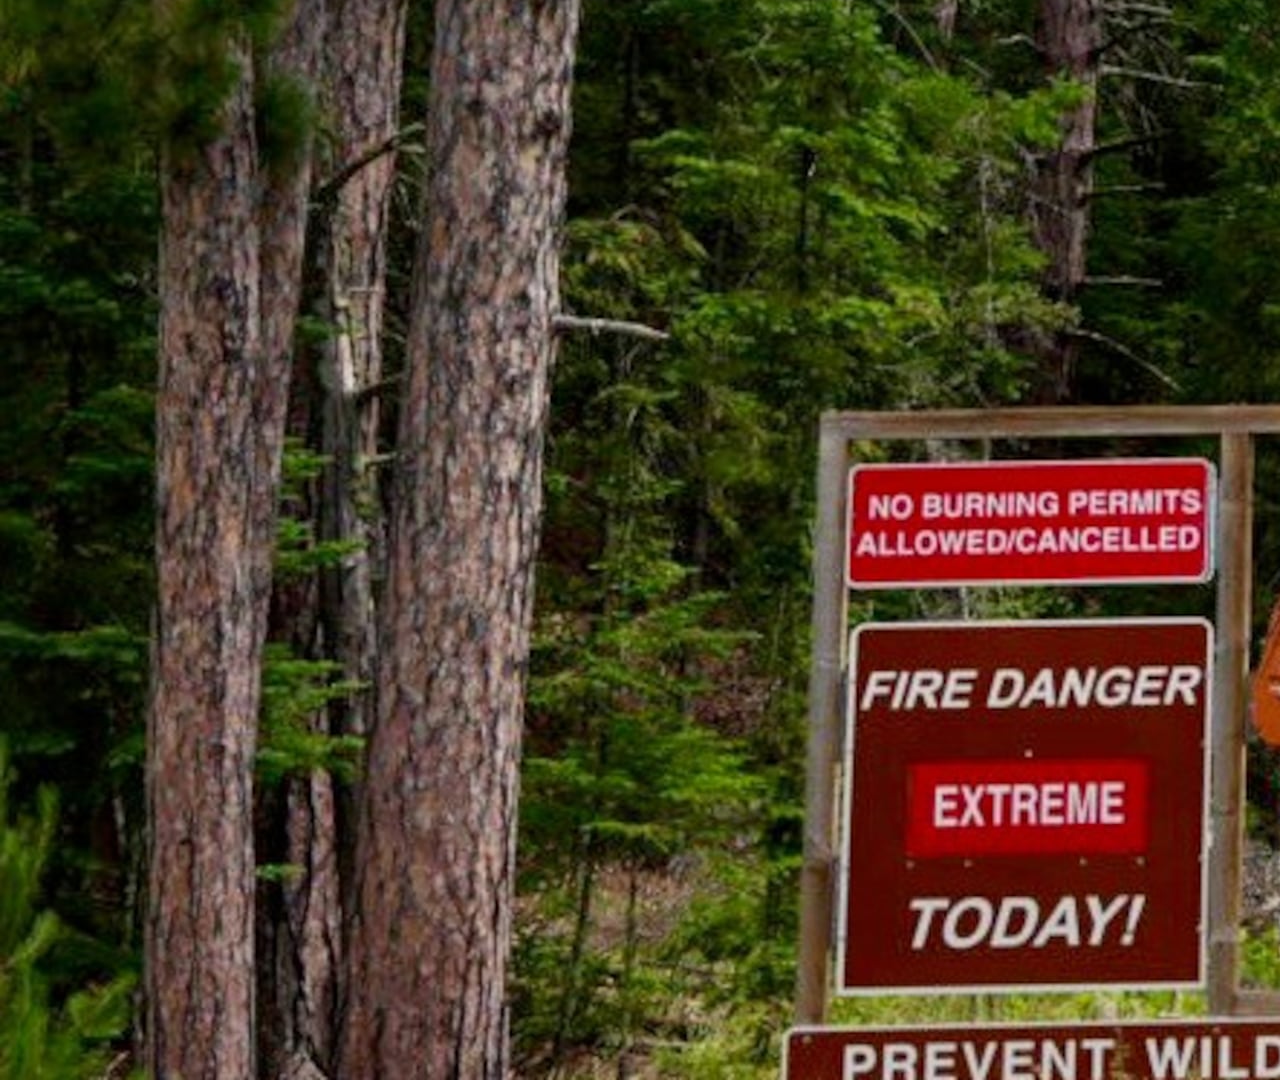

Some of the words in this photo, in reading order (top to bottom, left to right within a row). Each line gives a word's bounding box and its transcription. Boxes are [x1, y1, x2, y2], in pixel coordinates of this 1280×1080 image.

[868, 493, 914, 520] NO
[921, 491, 1059, 519] BURNING
[1068, 488, 1202, 516] PERMITS
[855, 525, 1201, 557] ALLOWED/CANCELLED
[859, 669, 978, 711] FIRE
[985, 665, 1203, 709] DANGER
[933, 781, 1126, 828] EXTREME
[908, 894, 1146, 950] TODAY!
[842, 1038, 1116, 1080] PREVENT
